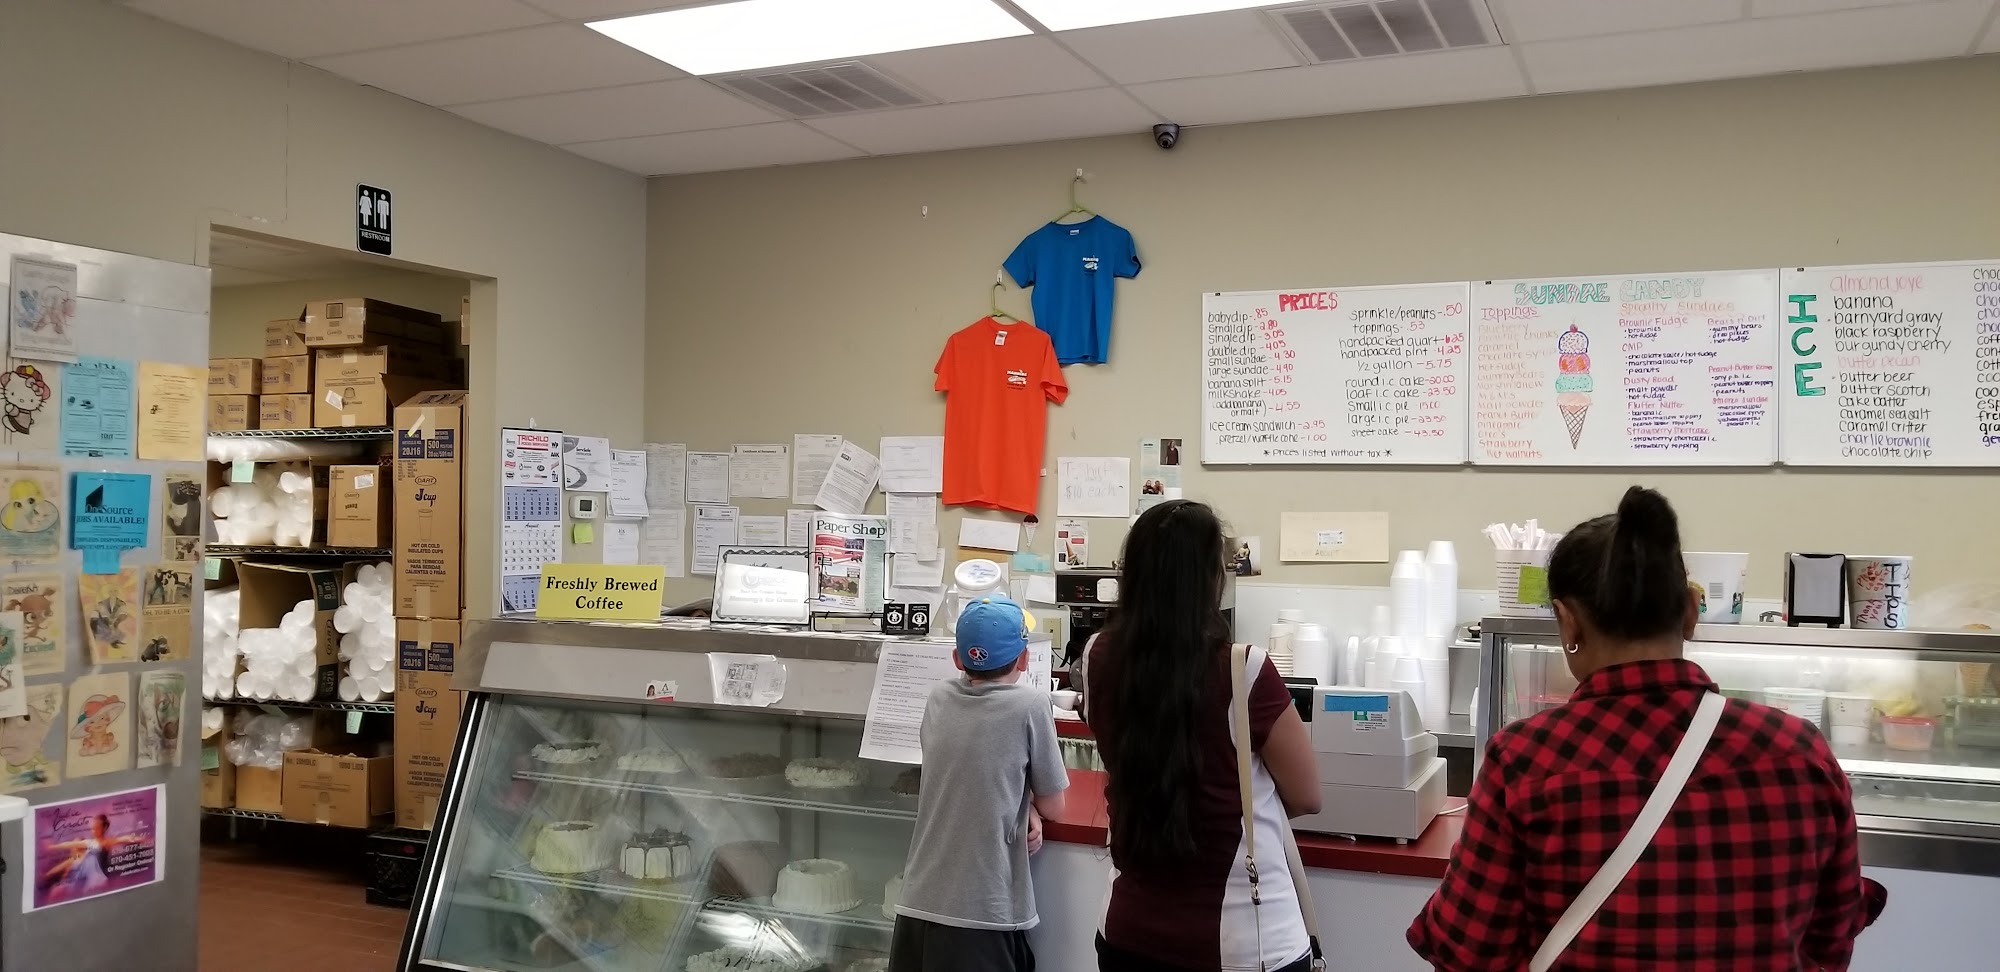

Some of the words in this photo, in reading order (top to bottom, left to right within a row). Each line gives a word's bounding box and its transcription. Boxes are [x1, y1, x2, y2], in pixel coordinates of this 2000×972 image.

[361, 231, 390, 243] RESTROOM
[1830, 275, 1890, 291] almond
[1515, 282, 1610, 305] SUNDAE
[1619, 278, 1704, 301] CANDY
[1834, 296, 1894, 310] banana
[1481, 306, 1538, 323] Toppings
[1655, 316, 1689, 328] Fudge
[1353, 323, 1400, 338] toppings
[1835, 326, 1869, 339] black
[1873, 325, 1941, 341] raspberry
[1406, 346, 1428, 358] pint
[1622, 342, 1644, 352] CMP
[1373, 360, 1413, 374] gallon
[1838, 355, 1876, 368] butter
[1881, 355, 1921, 368] pecan
[1629, 367, 1660, 375] peanuts
[1840, 371, 1880, 382] butter
[1884, 371, 1915, 382] beer
[1345, 376, 1379, 388] round
[1400, 376, 1424, 386] cake
[1393, 389, 1419, 398] cake
[1650, 384, 1678, 394] powder
[1841, 384, 1884, 395] butter
[1886, 385, 1931, 397] scotch
[1643, 392, 1666, 401] fudge
[1874, 396, 1909, 407] batter
[1395, 401, 1409, 413] pie
[1347, 413, 1376, 426] large
[1395, 414, 1409, 427] pie
[1253, 421, 1296, 433] sandwich
[1378, 428, 1399, 436] cake
[1627, 427, 1672, 436] Strawberry
[428, 440, 440, 449] 500
[517, 434, 549, 444] TRICHILO
[1302, 449, 1326, 457] listed
[1331, 449, 1364, 457] without
[1367, 449, 1380, 458] tax
[1842, 446, 1901, 457] chocolate
[1904, 446, 1932, 459] chip
[816, 520, 850, 533] Paper
[546, 576, 598, 592] Freshly
[604, 577, 658, 591] Brewed
[575, 595, 624, 610] Coffee
[429, 653, 440, 661] 500
